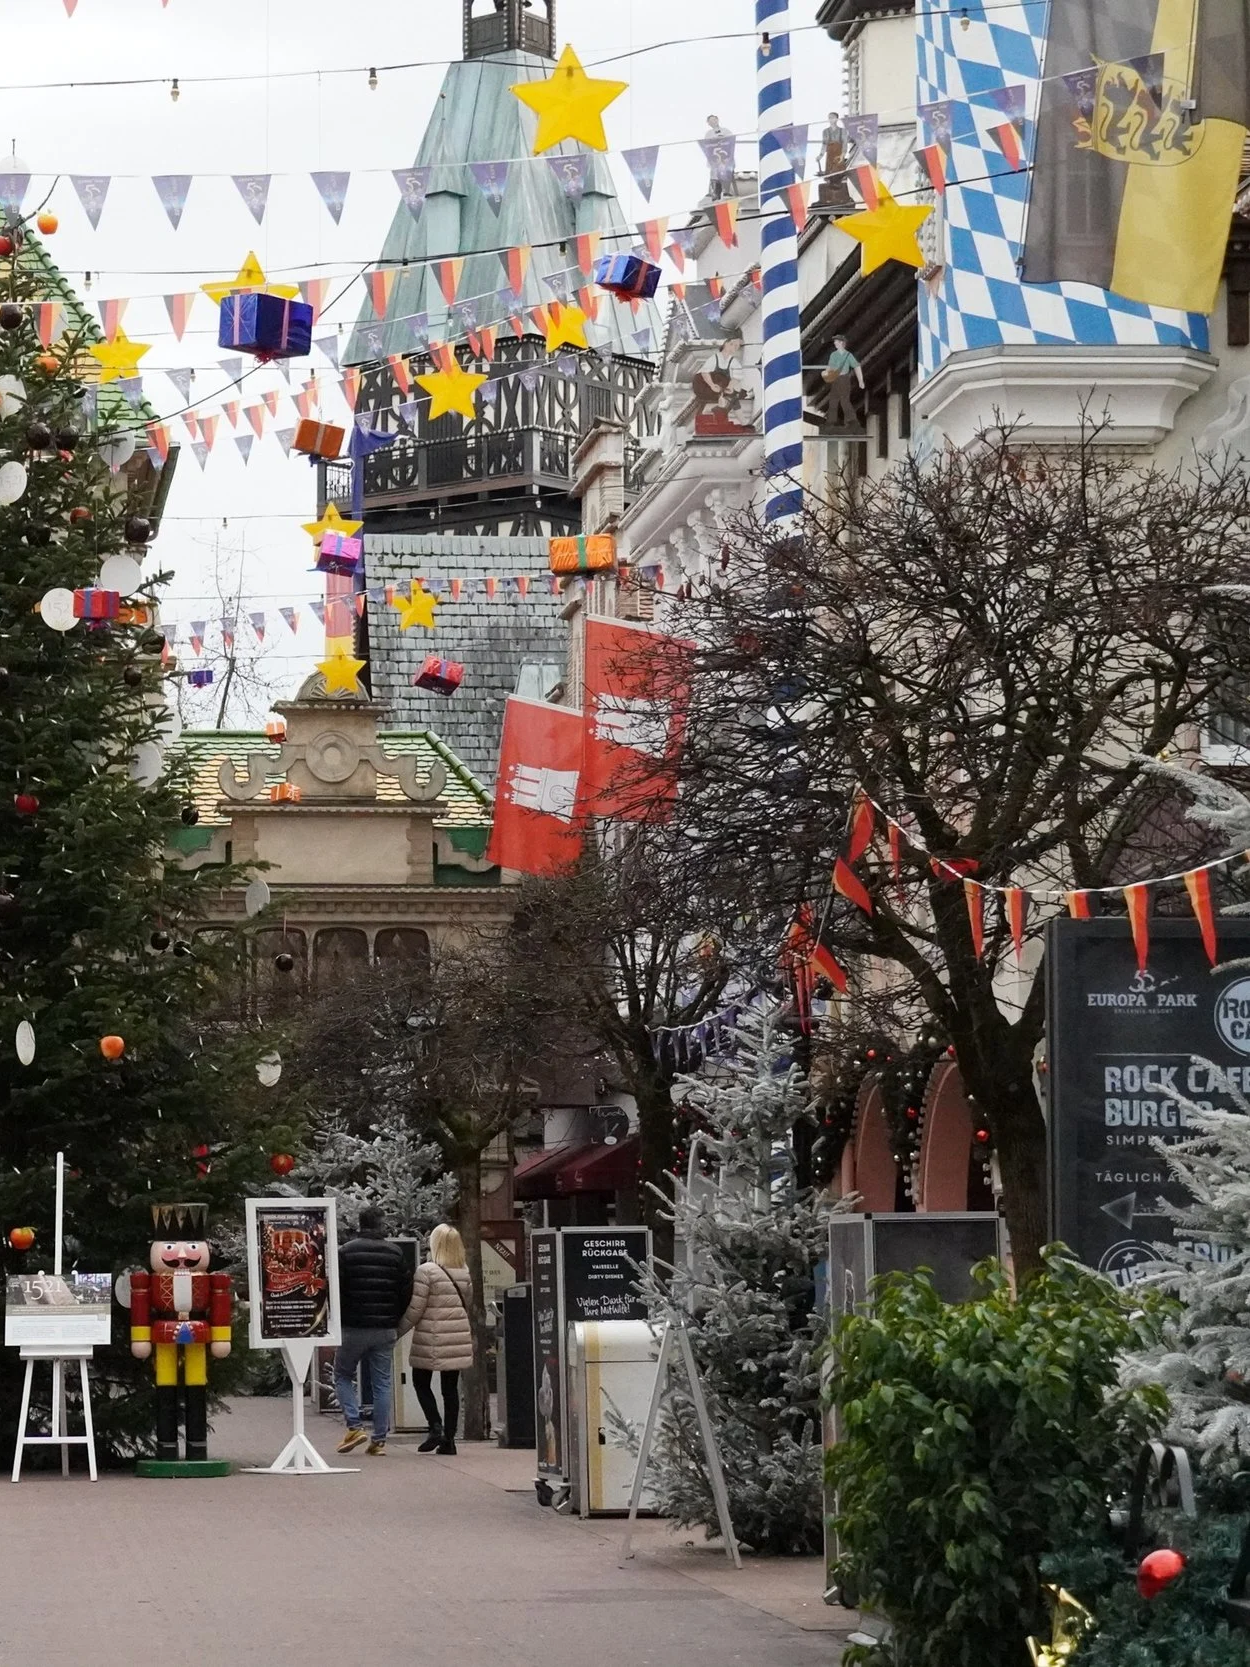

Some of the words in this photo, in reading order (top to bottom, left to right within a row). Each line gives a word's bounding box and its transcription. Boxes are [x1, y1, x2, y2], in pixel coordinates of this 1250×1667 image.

[1087, 993, 1147, 1006] EUROPA
[1157, 993, 1198, 1007] PARK
[1105, 1065, 1179, 1093] ROCK
[1095, 1170, 1161, 1182] TÄGLICH
[583, 1240, 626, 1248] GESCHIRR
[582, 1248, 628, 1257] RÜCKGABE
[24, 1281, 63, 1301] 1521
[576, 1297, 600, 1307] Vielen
[600, 1294, 623, 1305] Dank
[624, 1293, 636, 1304] für
[584, 1306, 599, 1316] Ihre
